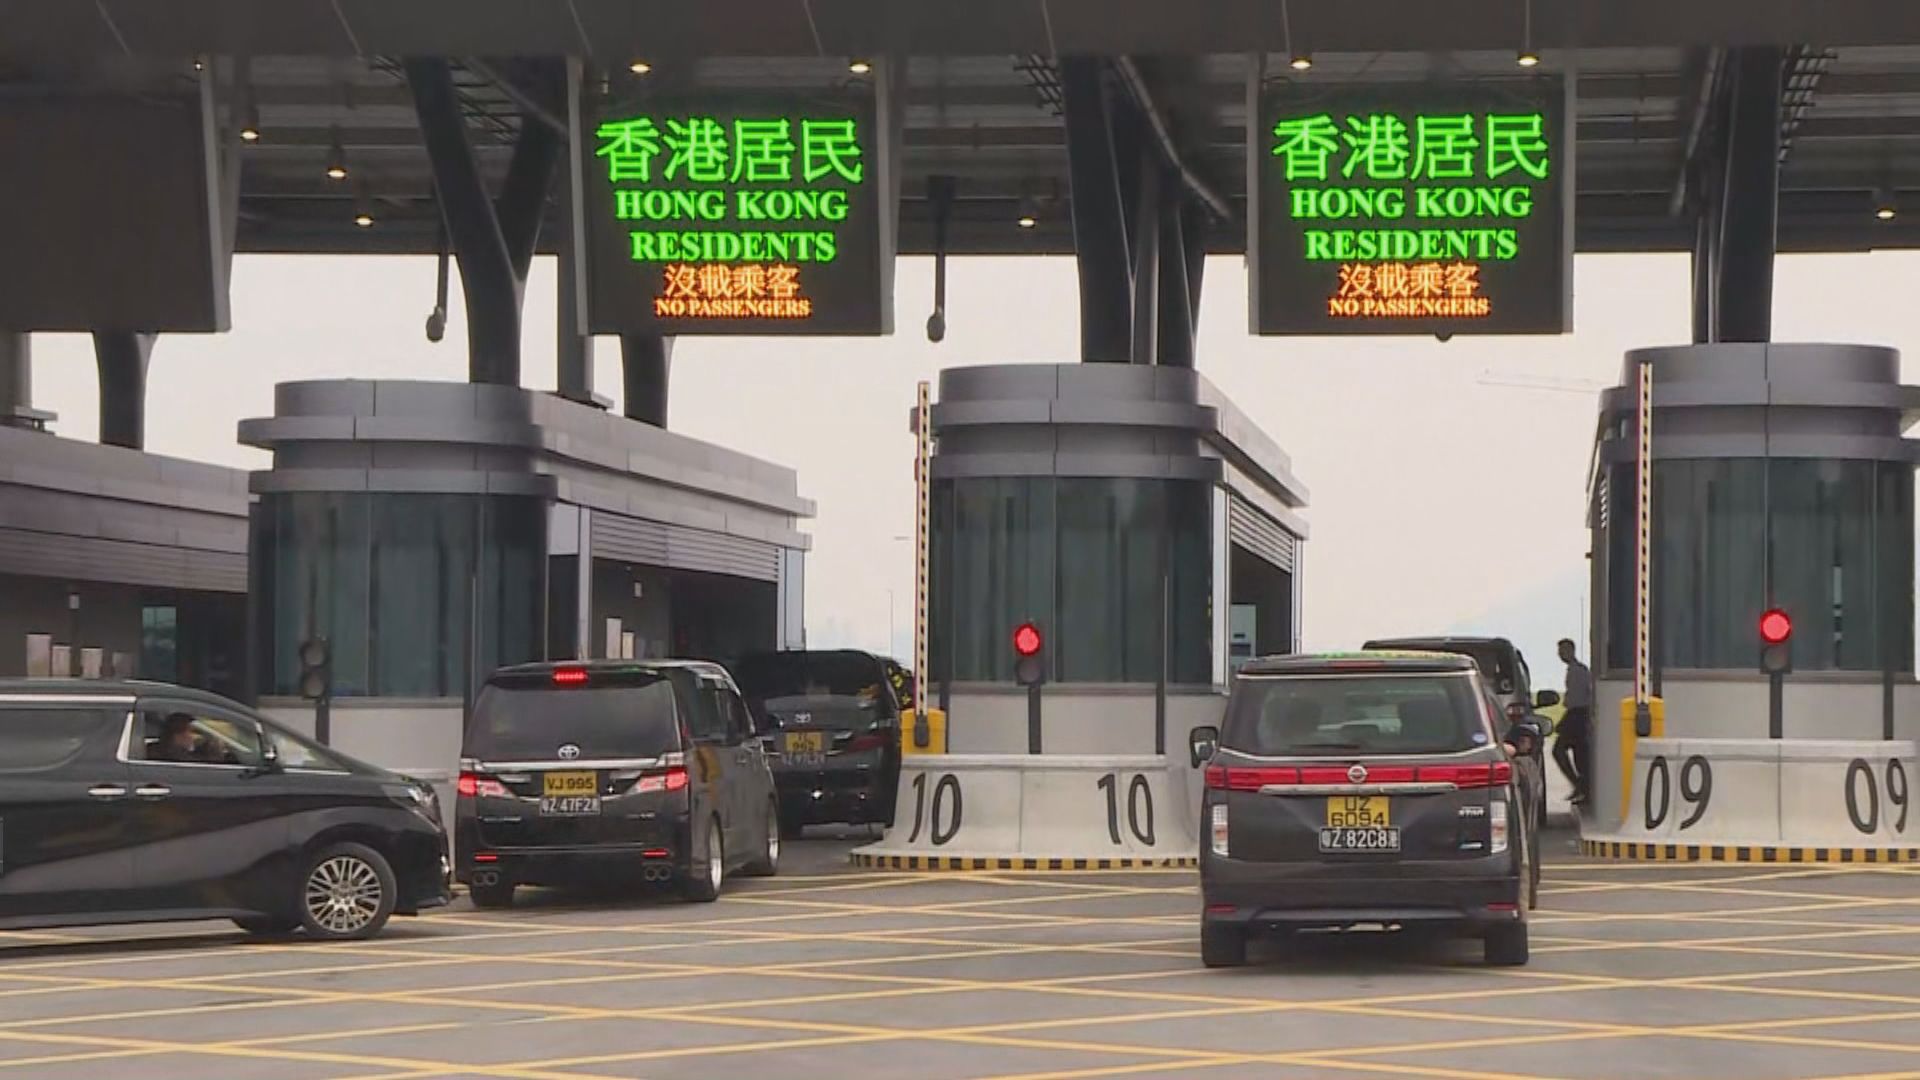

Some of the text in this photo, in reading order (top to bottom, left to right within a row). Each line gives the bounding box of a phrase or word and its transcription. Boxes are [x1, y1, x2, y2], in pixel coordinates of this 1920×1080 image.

[596, 117, 863, 183] 香港居民
[1273, 114, 1549, 181] 香港居民
[614, 190, 849, 220] HONG KONG
[1290, 187, 1533, 218] HONG KONG
[630, 231, 836, 262] RESIDENTS
[1304, 229, 1518, 260] RESIDENTS
[655, 298, 811, 316] NO PASSENGERS
[1329, 298, 1490, 316] NO PASSENGERS
[1345, 796, 1371, 811] UZ
[1645, 755, 1712, 830] 09
[1845, 758, 1908, 834] 09
[908, 772, 962, 846] 10
[1097, 774, 1155, 846] 10
[1331, 811, 1385, 827] 6094
